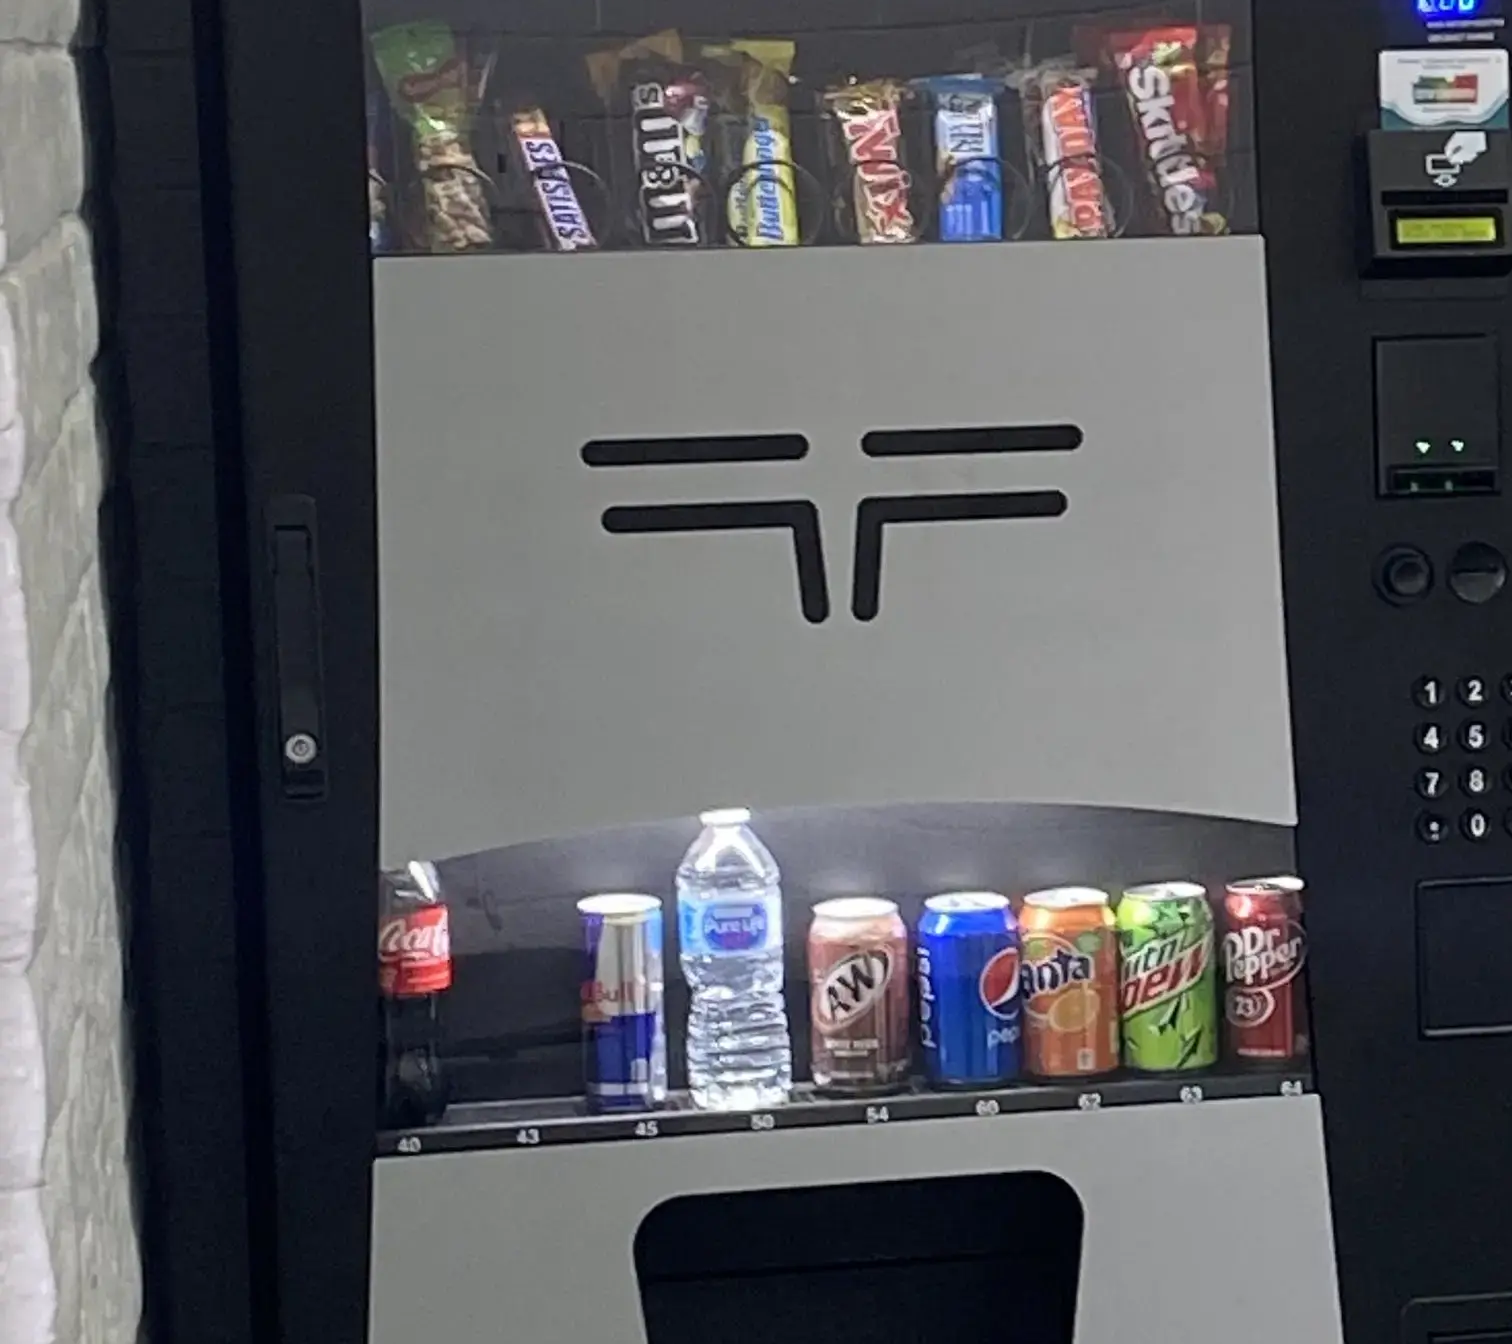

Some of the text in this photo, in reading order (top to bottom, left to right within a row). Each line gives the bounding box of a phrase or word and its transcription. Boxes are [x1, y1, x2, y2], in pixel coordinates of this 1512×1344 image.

[1129, 64, 1200, 235] Skittles
[1425, 681, 1437, 704] 1
[1468, 679, 1483, 702] 2
[1423, 726, 1439, 749] 4
[1468, 725, 1484, 749] 5
[1425, 772, 1439, 796] 7
[1469, 769, 1484, 793] 8
[1471, 814, 1485, 837] 0
[1241, 926, 1281, 960] Dr
[1224, 932, 1302, 985] Pepper
[1020, 949, 1091, 999] anta
[751, 1113, 776, 1130] 50
[866, 1106, 889, 1124] 54
[517, 1128, 540, 1144] 43
[635, 1120, 659, 1136] 45
[397, 1136, 422, 1153] 40
